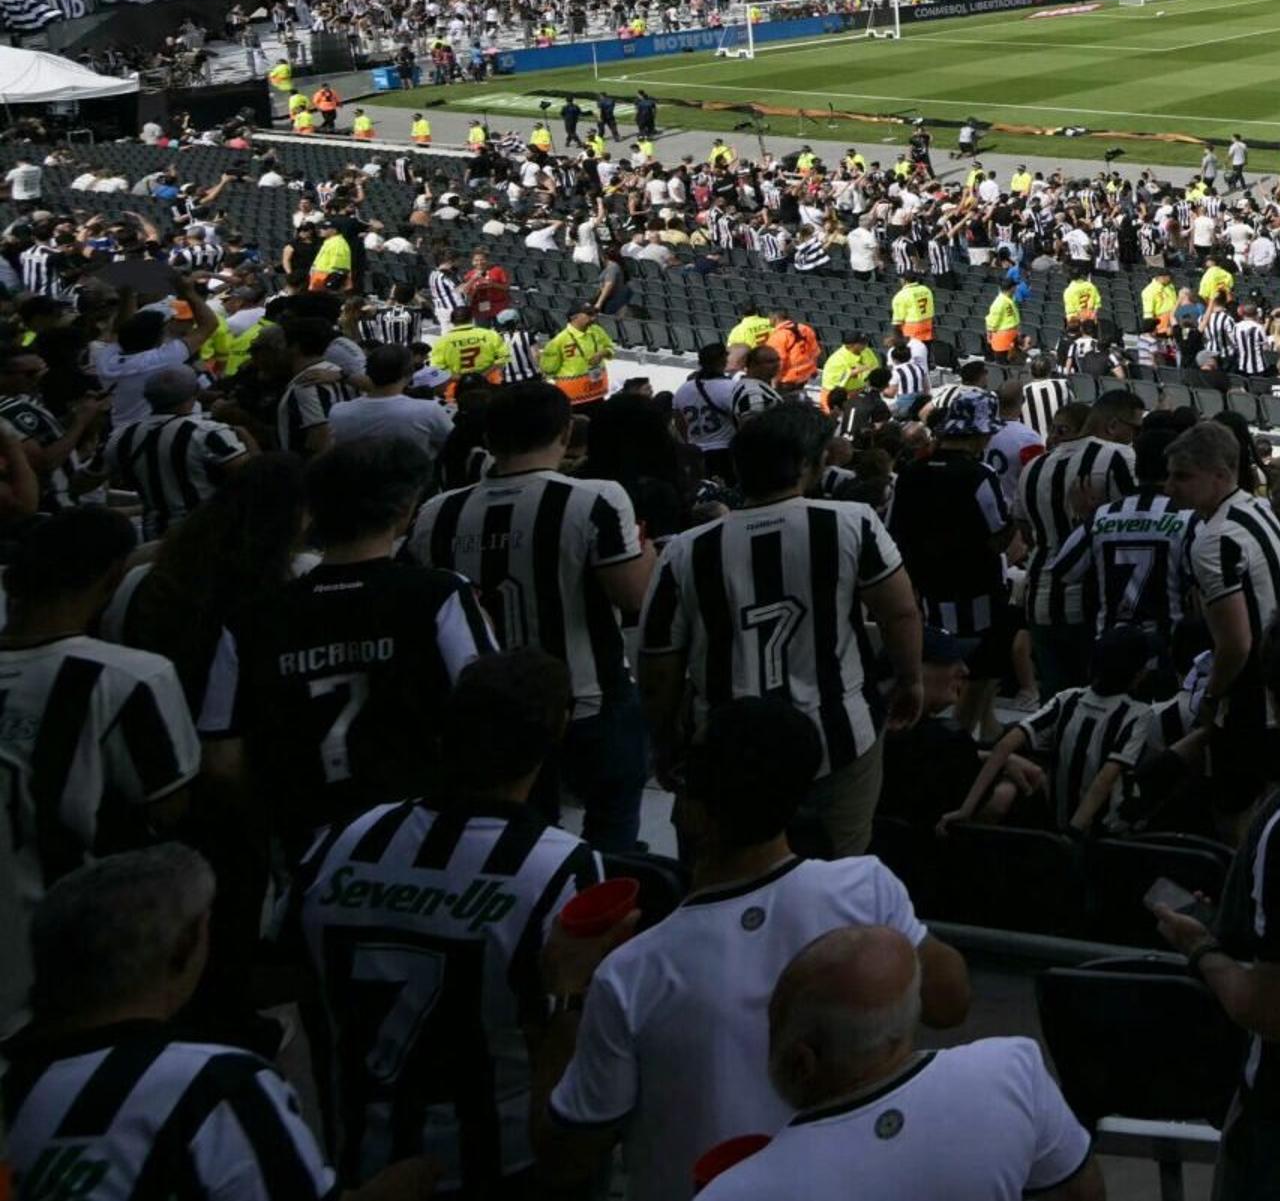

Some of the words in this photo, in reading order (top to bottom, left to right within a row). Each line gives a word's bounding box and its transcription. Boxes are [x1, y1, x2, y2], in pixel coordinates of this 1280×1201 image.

[914, 5, 968, 20] CONMEBOL
[449, 335, 489, 349] TECH
[1113, 545, 1157, 620] 7
[279, 636, 395, 676] RICARDO
[740, 595, 808, 693] 7
[303, 671, 371, 784] 7
[320, 865, 518, 933] Seven-Up
[349, 941, 448, 1085] 7
